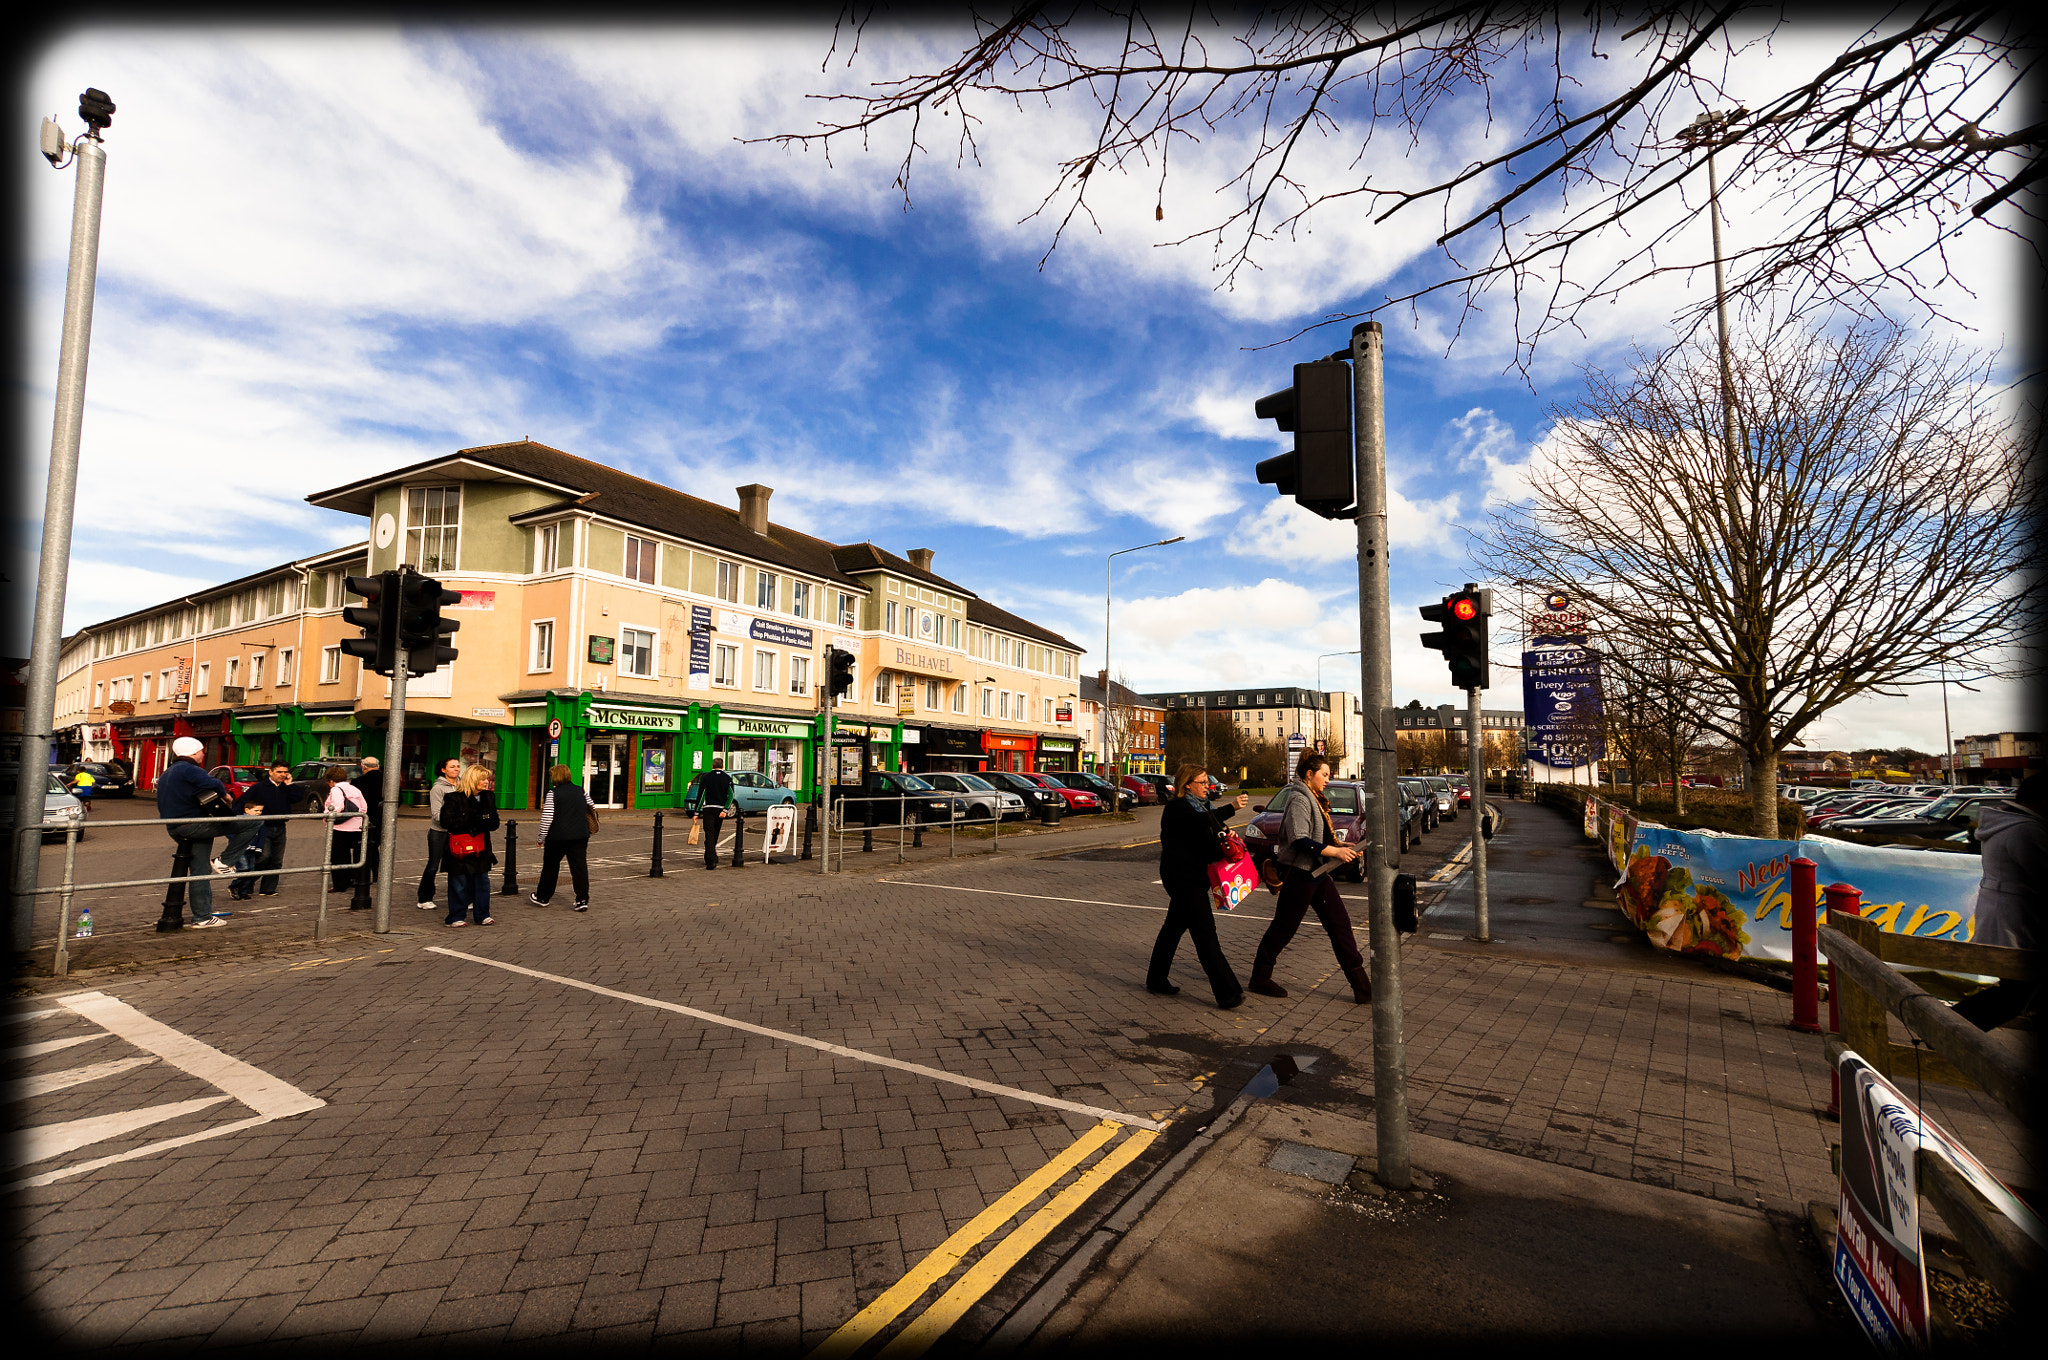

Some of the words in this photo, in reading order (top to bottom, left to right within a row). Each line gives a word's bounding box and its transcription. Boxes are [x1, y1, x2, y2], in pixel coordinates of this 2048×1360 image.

[755, 620, 765, 629] Quit
[896, 647, 953, 673] BELHAVEL
[1535, 650, 1587, 660] TESCO
[1529, 667, 1594, 677] PENNEYS
[1535, 681, 1564, 690] Elvery
[738, 719, 790, 734] PHARMACY
[1738, 854, 1790, 893] New
[1840, 1191, 1870, 1273] Moran,
[1872, 1252, 1901, 1320] Kevin
